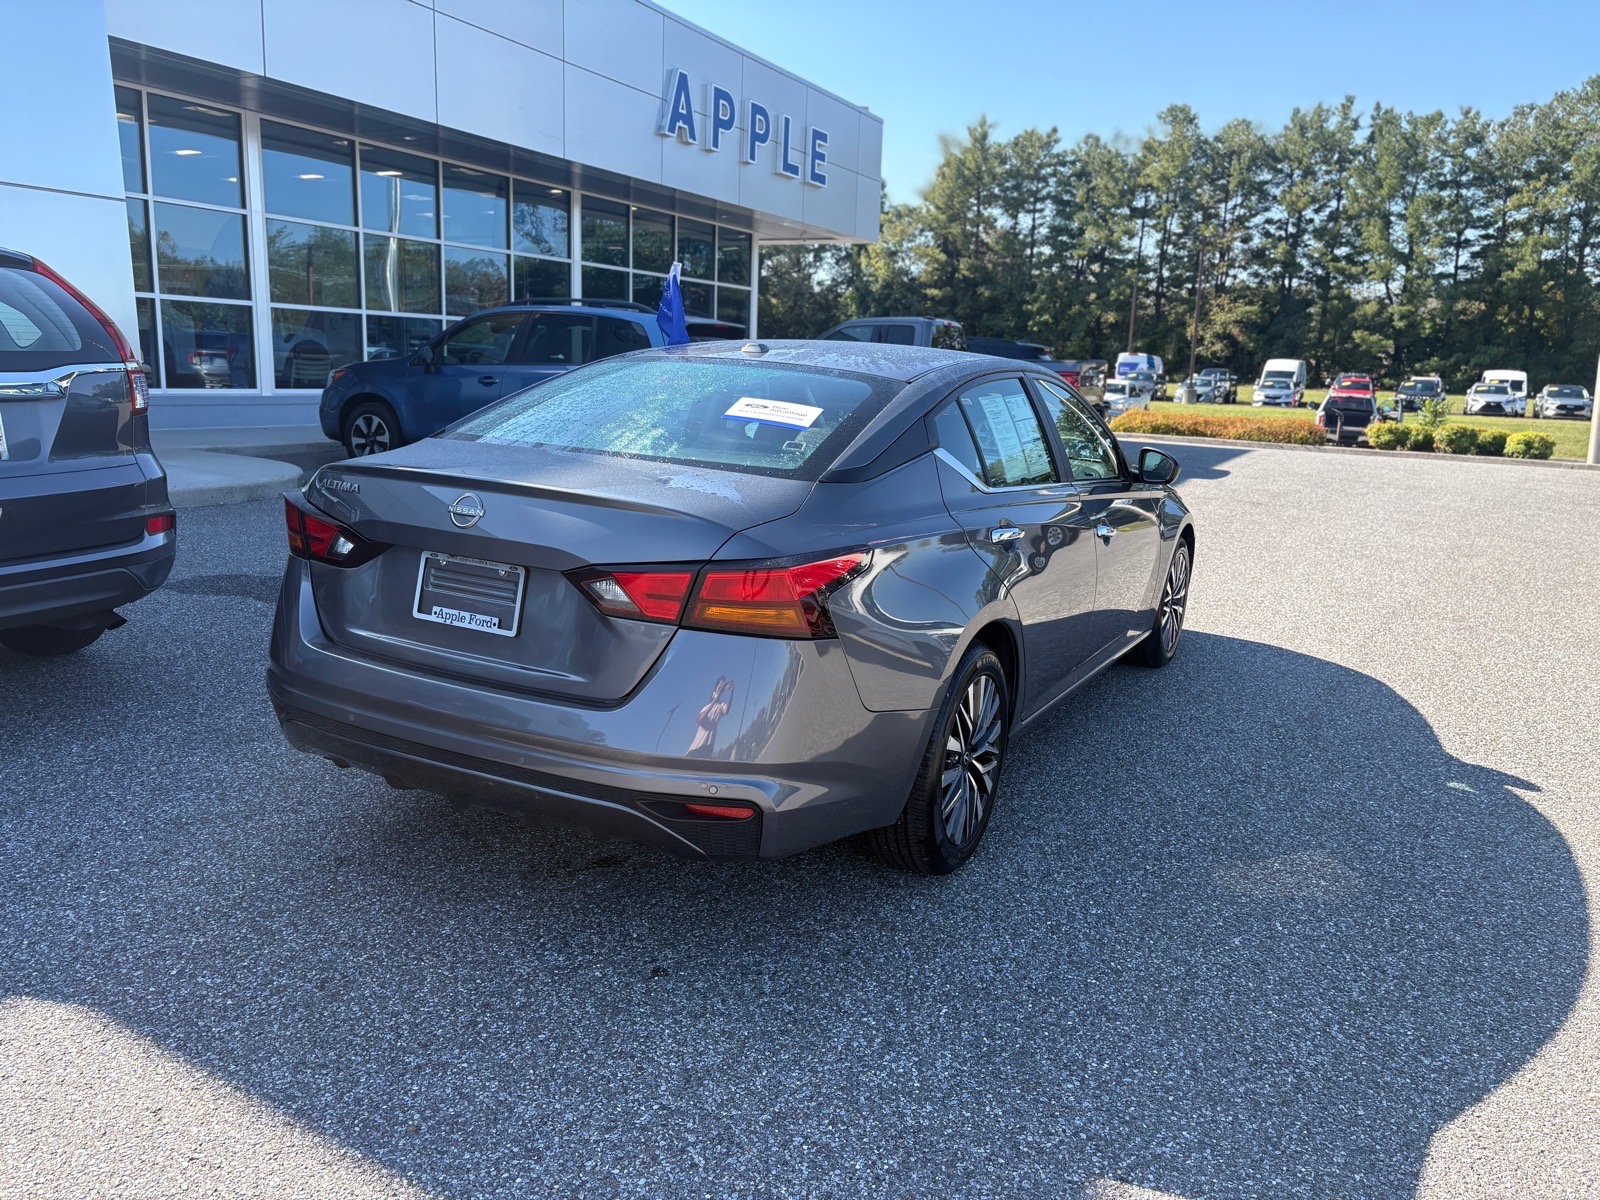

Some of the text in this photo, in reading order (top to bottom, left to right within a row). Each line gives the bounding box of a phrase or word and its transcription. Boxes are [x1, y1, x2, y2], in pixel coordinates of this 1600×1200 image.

[659, 68, 829, 188] APPLE
[320, 478, 360, 493] ALTIMA
[448, 505, 485, 517] NISSAN
[436, 608, 493, 629] Apple Ford
